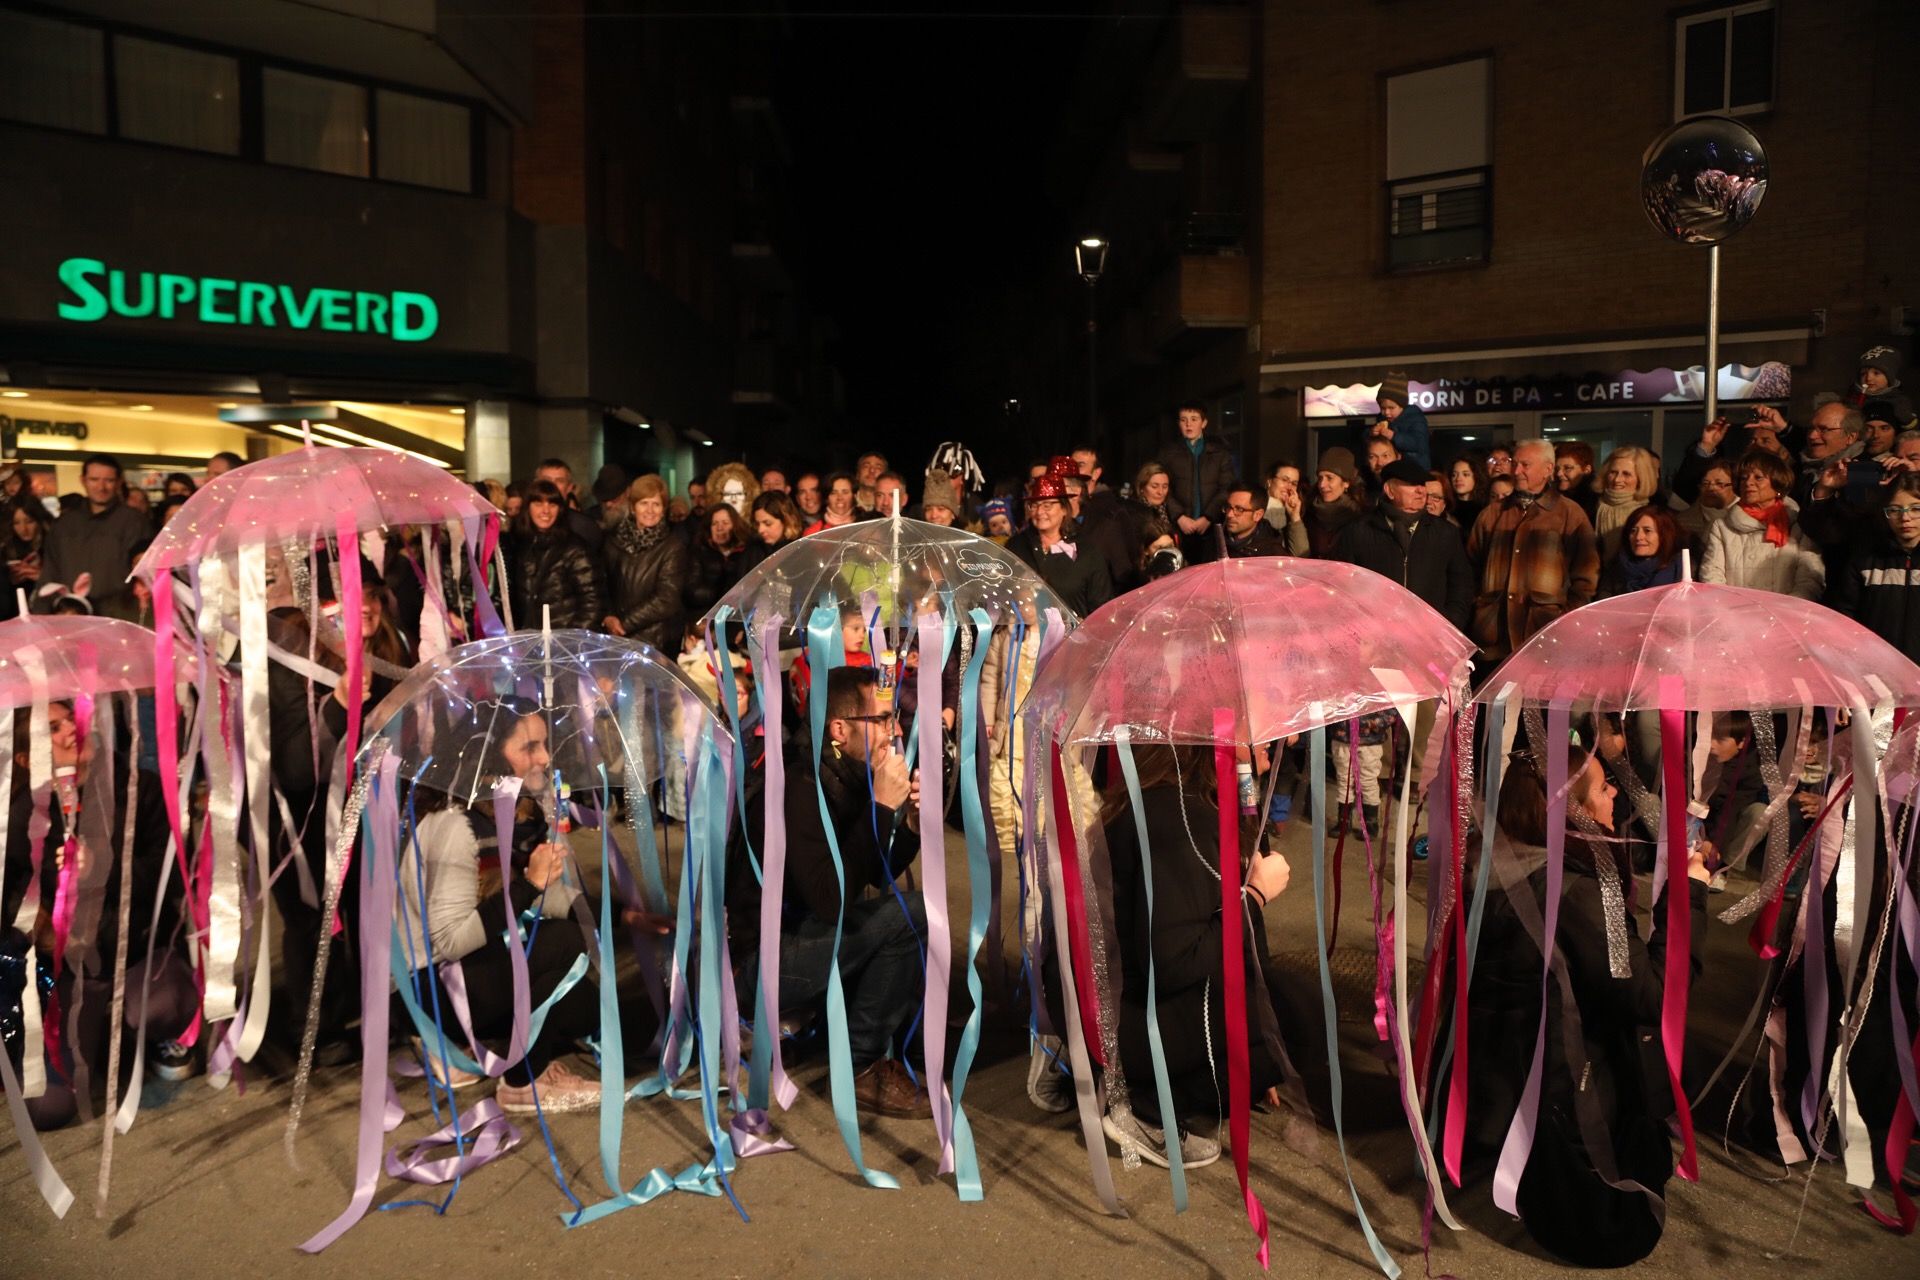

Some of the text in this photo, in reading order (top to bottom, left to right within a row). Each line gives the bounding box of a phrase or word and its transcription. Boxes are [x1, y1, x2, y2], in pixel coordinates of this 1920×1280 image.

[58, 257, 439, 341] SUPERVERD
[1408, 390, 1465, 408] FORN
[1475, 388, 1502, 405] DE
[1512, 386, 1541, 403] PA
[1577, 381, 1634, 401] CAFE
